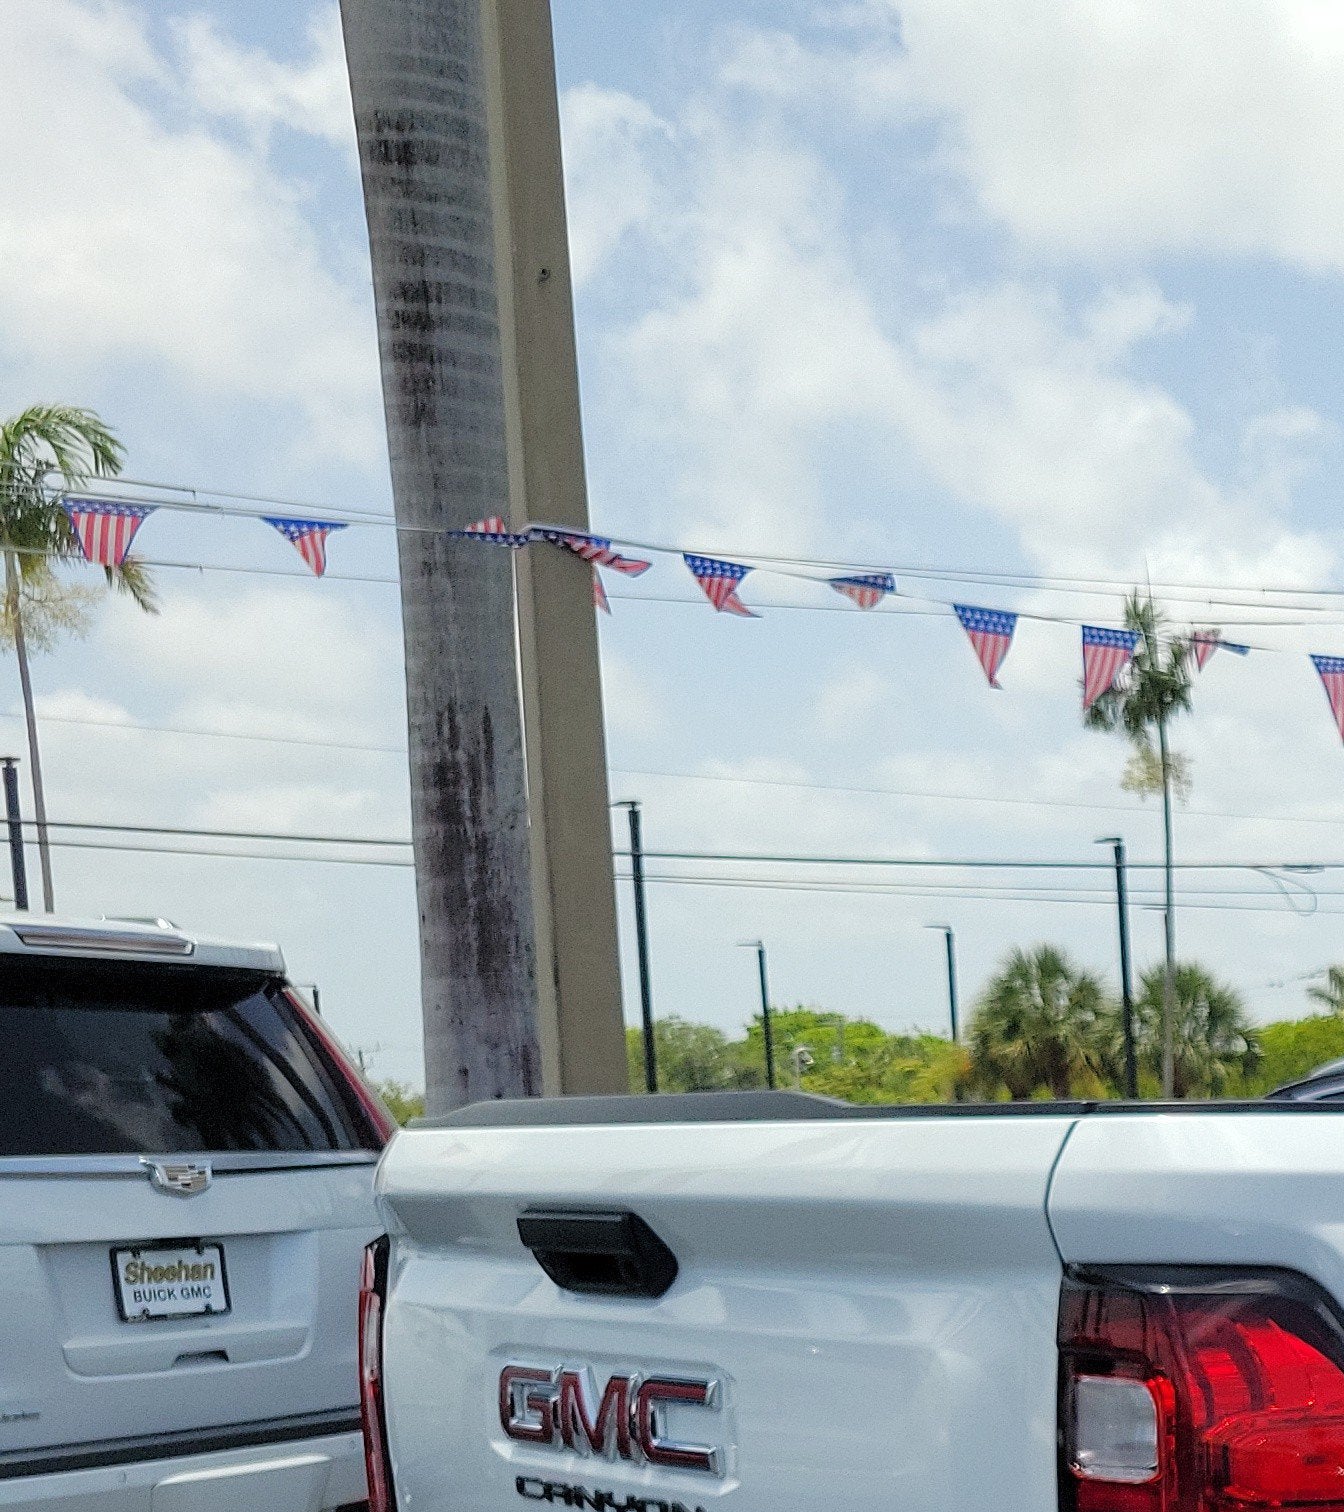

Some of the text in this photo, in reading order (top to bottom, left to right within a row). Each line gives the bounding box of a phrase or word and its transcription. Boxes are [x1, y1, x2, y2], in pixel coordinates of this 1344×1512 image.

[125, 1260, 215, 1285] Sheehan
[133, 1285, 212, 1303] BUICK GMC
[499, 1361, 725, 1480] GMC
